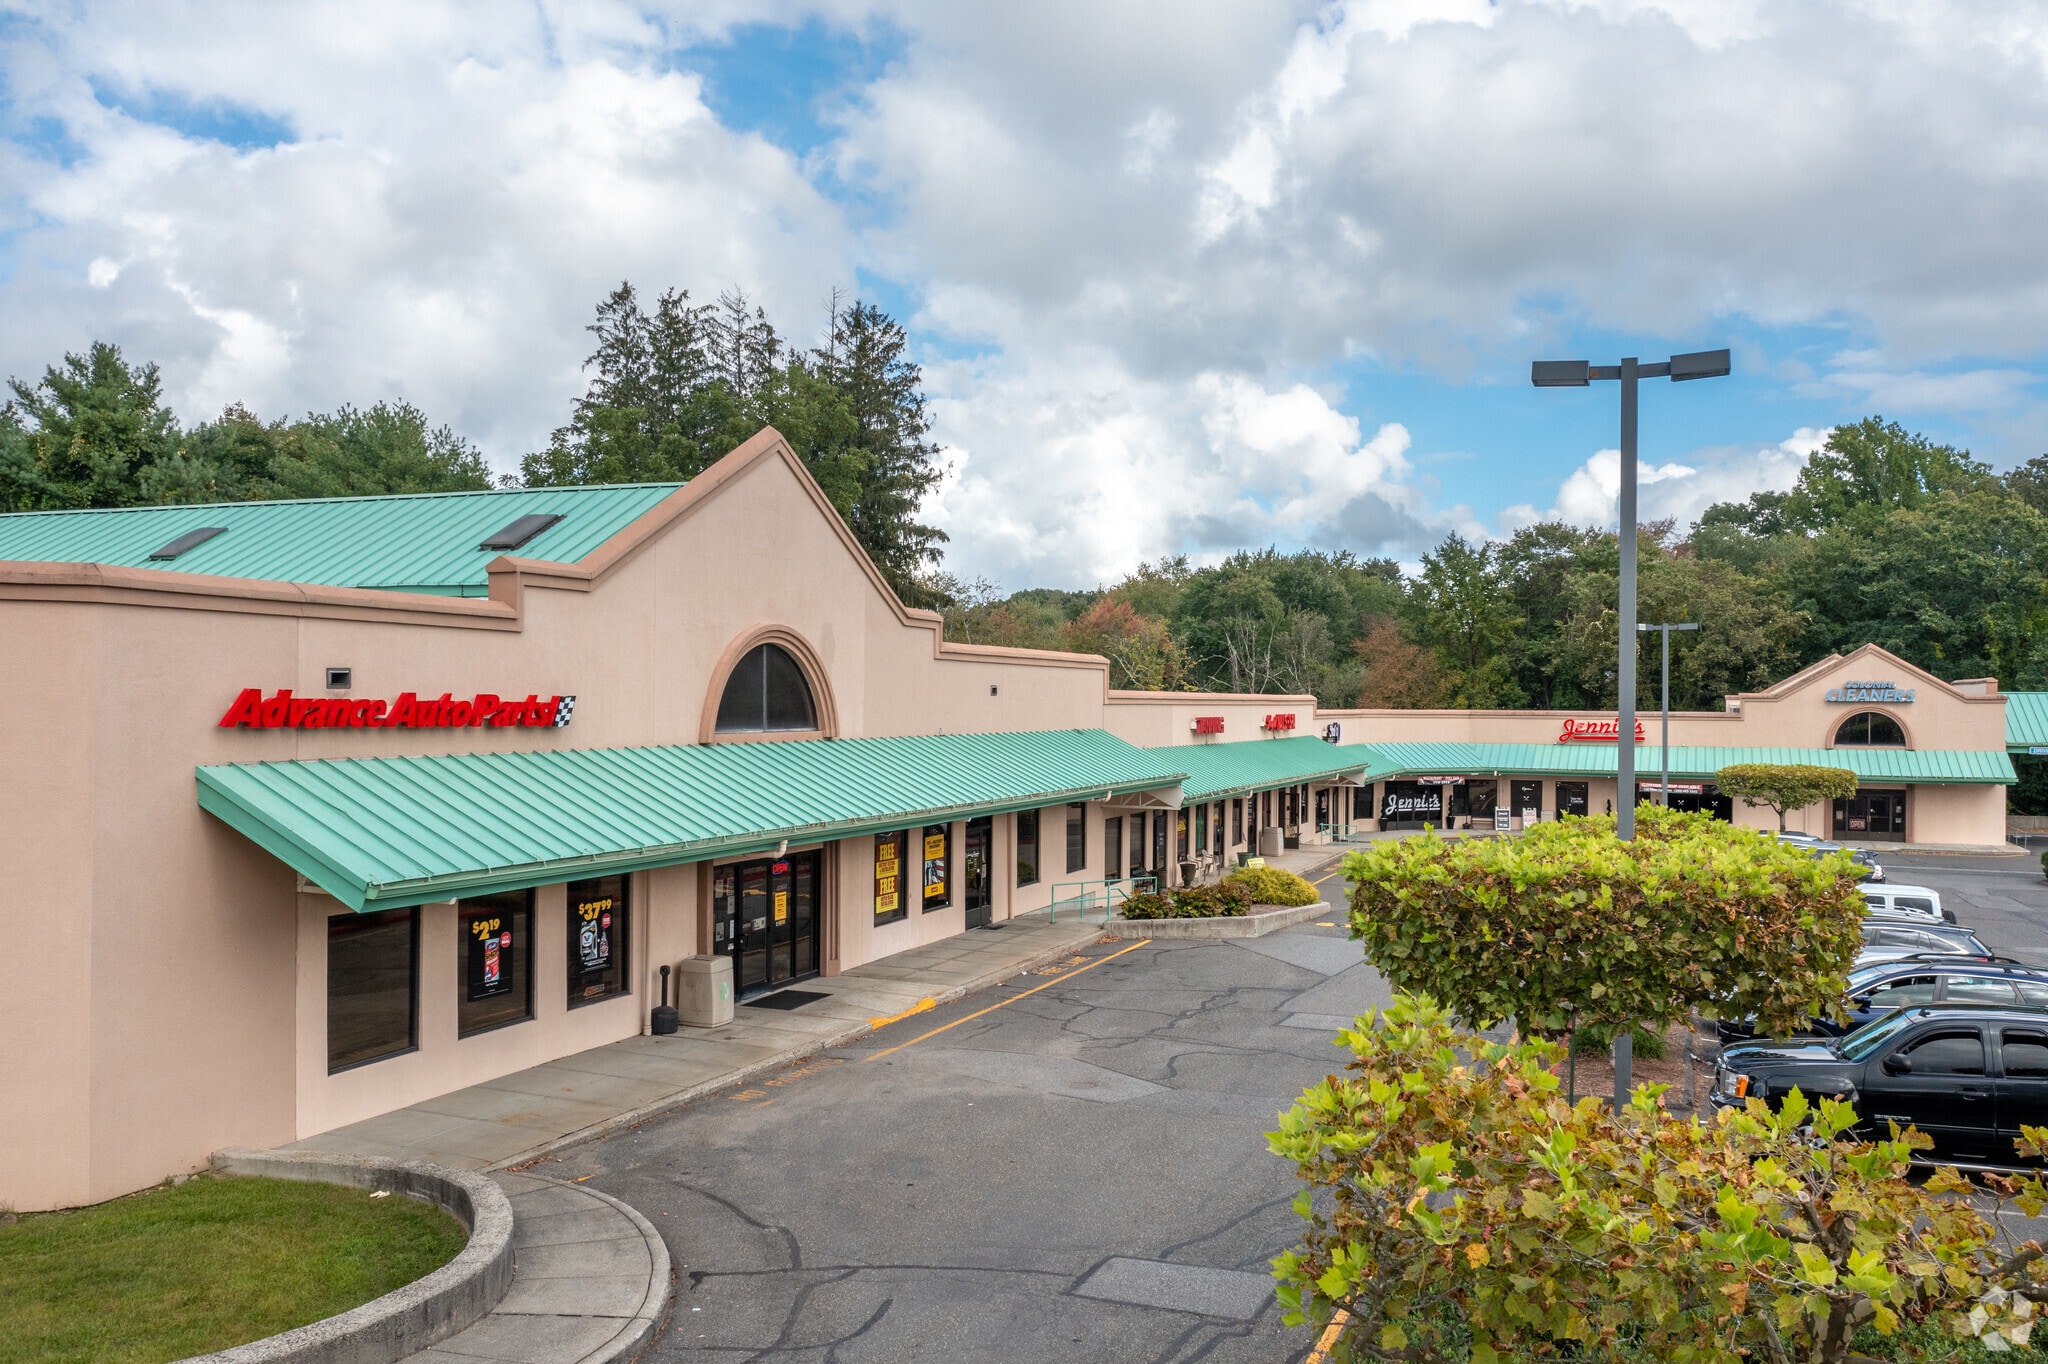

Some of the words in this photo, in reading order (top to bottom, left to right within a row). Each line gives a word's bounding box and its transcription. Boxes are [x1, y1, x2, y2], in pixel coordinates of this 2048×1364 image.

[1844, 680, 1896, 689] COLONIAL
[1825, 688, 1916, 702] CLEANERS
[218, 688, 387, 729] Advance
[382, 692, 473, 728] Auto
[1559, 717, 1645, 742] Jenni's
[880, 843, 895, 860] FREE
[772, 862, 788, 873] OPEN
[880, 877, 895, 895] FREE
